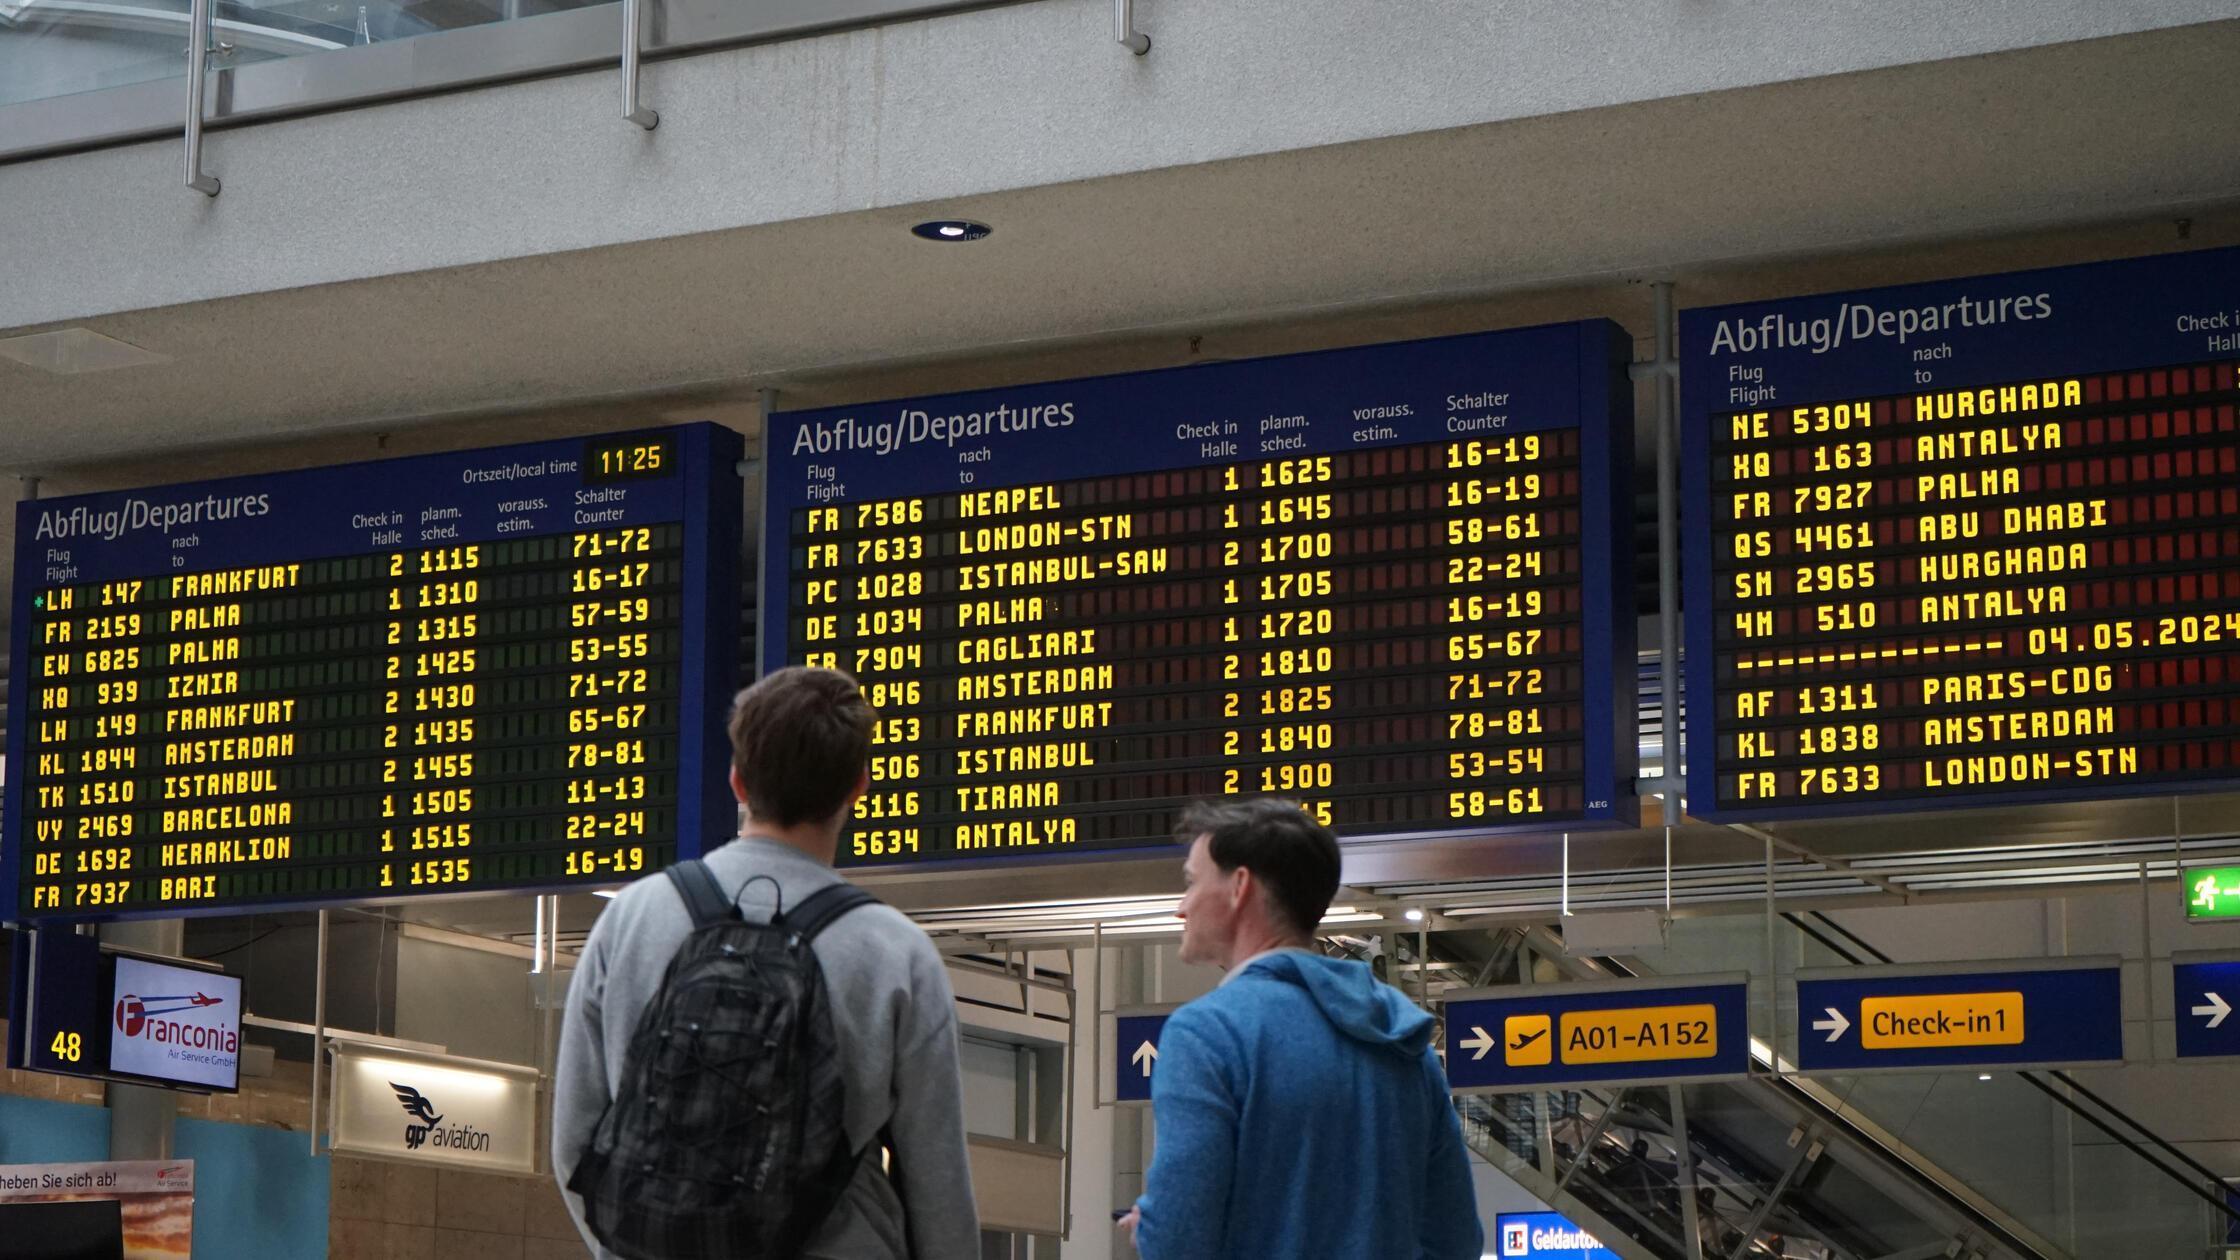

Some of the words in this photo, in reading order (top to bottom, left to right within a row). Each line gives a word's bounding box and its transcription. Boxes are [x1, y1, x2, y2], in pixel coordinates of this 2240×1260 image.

[1709, 292, 2052, 356] Abflug/Departures
[2176, 311, 2230, 333] Check
[1913, 342, 1952, 362] nach
[1729, 364, 1763, 384] Flug
[1914, 369, 1933, 384] to
[1446, 391, 1509, 412] Schalter
[1729, 384, 1776, 407] Flight
[1732, 412, 1769, 441] NE
[1793, 401, 1871, 434] 5304
[1916, 380, 2081, 422] HURGHADA
[1260, 414, 1310, 435] planm.
[1352, 404, 1414, 421] vorauss.
[1446, 414, 1508, 433] Counter
[791, 402, 1075, 456] Abflug/Departures
[1176, 420, 1220, 440] Check
[1224, 419, 1238, 435] in
[1260, 432, 1307, 452] sched.
[1352, 424, 1398, 442] estim.
[601, 445, 661, 474] 11:25
[959, 445, 991, 464] nach
[1201, 440, 1238, 458] Halle
[1814, 441, 1872, 472] 163
[1917, 422, 2061, 462] ANTALYA
[462, 460, 545, 484] Ortszeit/local
[549, 459, 578, 474] time
[807, 464, 836, 482] Flug
[808, 507, 839, 534] FR
[858, 499, 923, 529] 7586
[960, 485, 1061, 517] NEAPEL
[1261, 456, 1331, 488] 1625
[1447, 435, 1540, 469] 16-19
[959, 470, 974, 484] to
[497, 498, 548, 513] vorauss.
[575, 487, 627, 505] Schalter
[807, 482, 846, 503] Flight
[1734, 491, 1771, 520] FR
[1794, 481, 1873, 513] 7927
[1918, 467, 2020, 502] PALMA
[35, 493, 270, 542] Abflug/Departures
[352, 511, 388, 529] Check
[391, 510, 403, 525] in
[421, 506, 462, 526] planm.
[496, 516, 534, 533] estim.
[574, 508, 625, 525] Counter
[808, 543, 839, 569] FR
[857, 535, 923, 565] 7633
[959, 514, 1131, 555] LONDON-STN
[1447, 474, 1540, 507] 16-19
[1734, 531, 1771, 559] QS
[1795, 521, 1874, 553] 4461
[1919, 511, 1979, 542] ABU
[2004, 499, 2107, 535] DHABI
[172, 532, 199, 549] nach
[372, 529, 402, 546] Halle
[420, 523, 459, 541] sched.
[47, 548, 71, 565] Flug
[47, 588, 73, 612] LH
[101, 580, 142, 606] 147
[172, 564, 300, 599] FRANKFURT
[420, 545, 479, 574] 1115
[573, 528, 650, 557] 71-72
[172, 554, 185, 568] to
[807, 579, 838, 605] PC
[857, 571, 922, 601] 1028
[959, 547, 1167, 591] ISTANBUL-SAW
[1260, 532, 1332, 563] 1700
[1796, 561, 1875, 594] 2965
[1920, 543, 2087, 583] HURGHADA
[46, 565, 78, 584] Flight
[86, 613, 141, 640] 2159
[170, 603, 241, 632] PALMA
[572, 562, 650, 593] 16-17
[806, 615, 837, 641] DE
[856, 607, 922, 637] 1034
[958, 597, 1043, 628] PALMA
[1448, 551, 1541, 584] 22-24
[1736, 610, 1773, 638] 4M
[1817, 602, 1876, 632] 510
[1921, 585, 2066, 623] ANTALYA
[43, 653, 70, 677] EW
[85, 646, 139, 673] 6825
[169, 637, 239, 665] PALMA
[417, 614, 477, 642] 1315
[856, 644, 921, 673] 7904
[958, 629, 1095, 664] CAGLIARI
[1261, 608, 1332, 639] 1720
[2028, 612, 2240, 655] 04.05.2024
[42, 686, 68, 710] XQ
[98, 680, 138, 705] 939
[168, 671, 238, 699] IZMIR
[571, 633, 648, 663] 53-55
[958, 664, 1113, 701] AMSTERDAM
[1449, 629, 1542, 661] 65-67
[1798, 683, 1878, 714] 1311
[1923, 665, 2112, 705] PARIS-CDG
[96, 713, 137, 738] 149
[166, 699, 295, 732] FRANKFURT
[415, 684, 475, 711] 1430
[957, 702, 1113, 738] FRANKFURT
[1261, 685, 1332, 715] 1825
[39, 753, 65, 776] KL
[81, 746, 136, 773] 1844
[165, 733, 294, 766] AMSTERDAM
[569, 704, 646, 733] 65-67
[957, 741, 1094, 775] ISTANBUL
[1449, 708, 1543, 740] 78-81
[1738, 731, 1775, 758] KL
[1799, 723, 1879, 755] 1838
[1924, 706, 2114, 746] AMSTERDAM
[38, 785, 64, 809] TK
[79, 780, 134, 806] 1510
[164, 769, 278, 799] ISTANBUL
[413, 753, 473, 781] 1455
[1738, 771, 1776, 799] FR
[1800, 764, 1880, 795] 7633
[1925, 746, 2137, 787] LONDON-STN
[853, 791, 919, 819] 5116
[958, 781, 1059, 812] TIRANA
[1261, 762, 1332, 792] 1900
[1588, 800, 1608, 809] AEG
[78, 814, 133, 839] 2469
[163, 802, 292, 833] BARCELONA
[567, 775, 645, 804] 11-13
[853, 828, 919, 856] 5634
[956, 818, 1076, 849] ANTALYA
[1449, 787, 1542, 818] 58-61
[35, 852, 62, 875] DE
[77, 847, 132, 873] 1692
[161, 836, 290, 867] HERAKLION
[411, 823, 471, 850] 1515
[34, 885, 60, 908] FR
[76, 880, 130, 906] 7937
[160, 875, 216, 901] BARI
[565, 847, 643, 875] 16-19
[116, 994, 237, 1053] Franconia
[1568, 1020, 1709, 1051] A01-A152
[51, 1031, 81, 1062] 48
[167, 1048, 180, 1059] Air
[181, 1050, 210, 1064] Service
[405, 1124, 428, 1150] gp
[432, 1123, 490, 1152] aviation
[42, 1173, 62, 1189] Sie
[65, 1172, 93, 1187] sich
[96, 1171, 117, 1187] ab!
